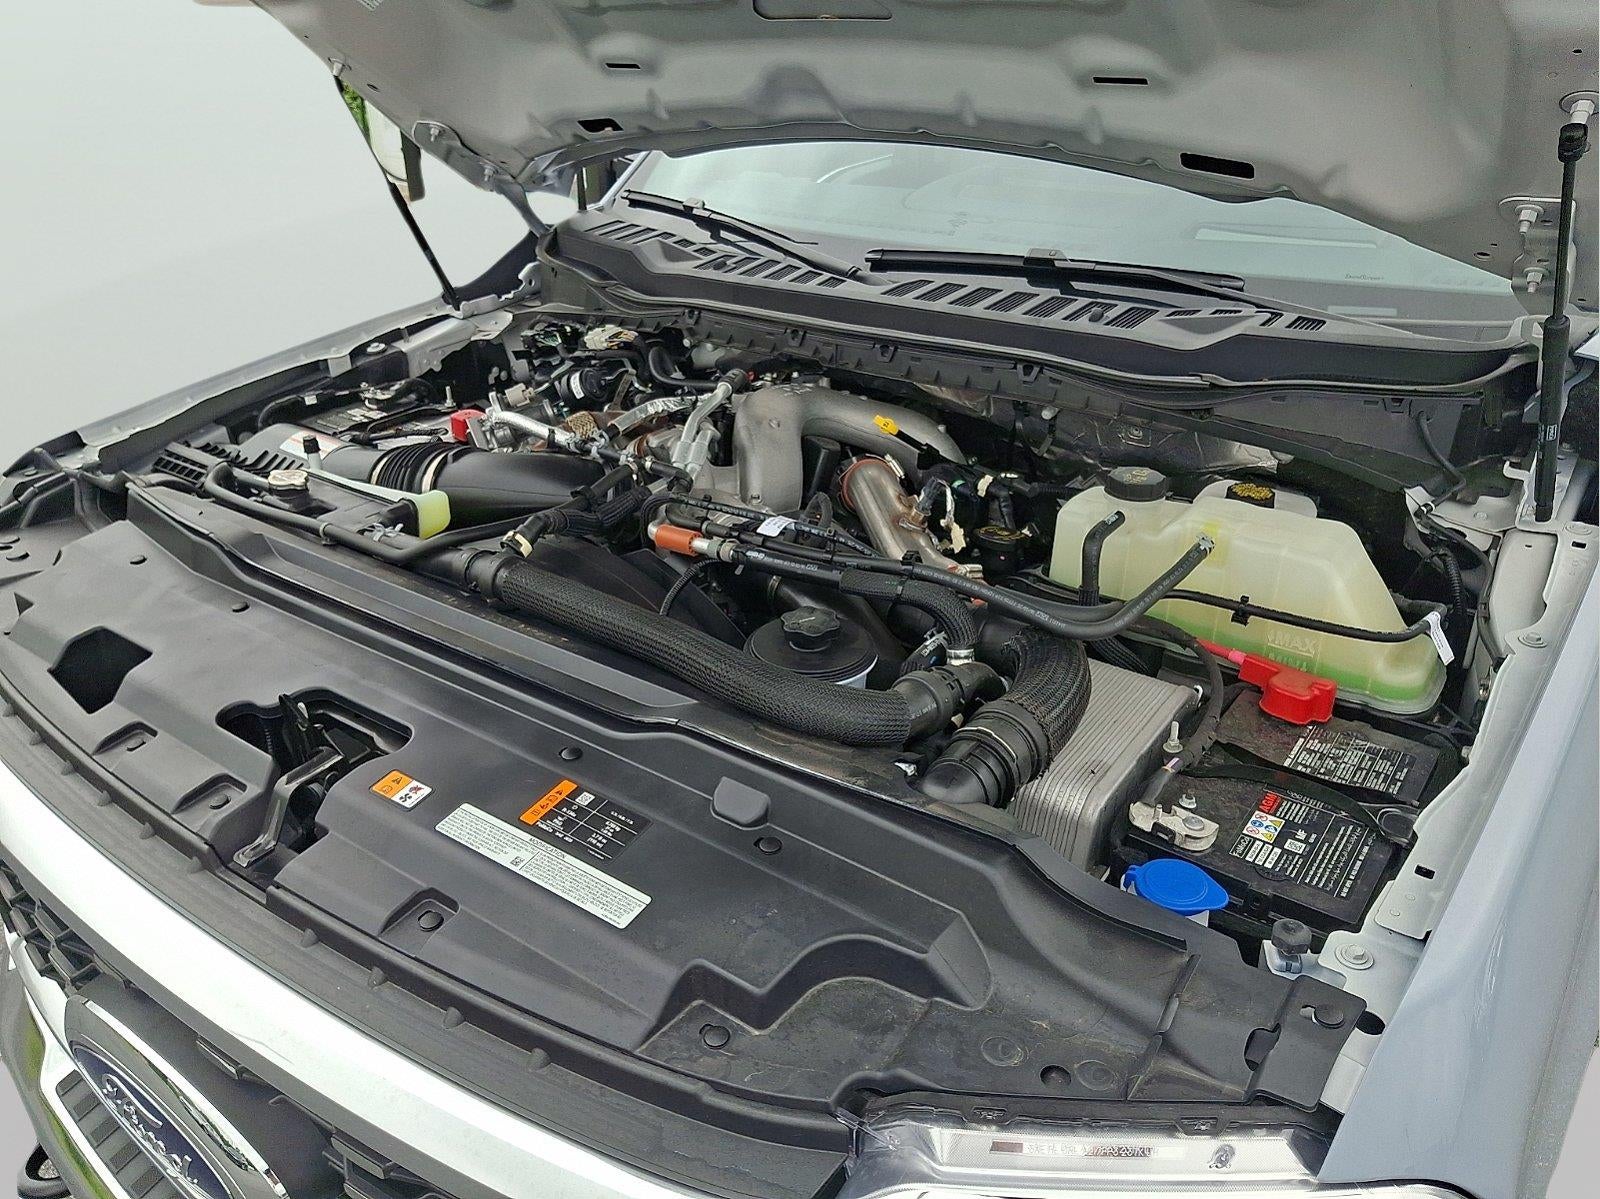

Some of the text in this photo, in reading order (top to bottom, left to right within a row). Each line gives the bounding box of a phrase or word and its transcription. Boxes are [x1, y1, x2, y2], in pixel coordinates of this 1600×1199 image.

[1259, 792, 1278, 813] AGM
[529, 837, 567, 860] MODIFICATION
[102, 1073, 199, 1185] Ford
